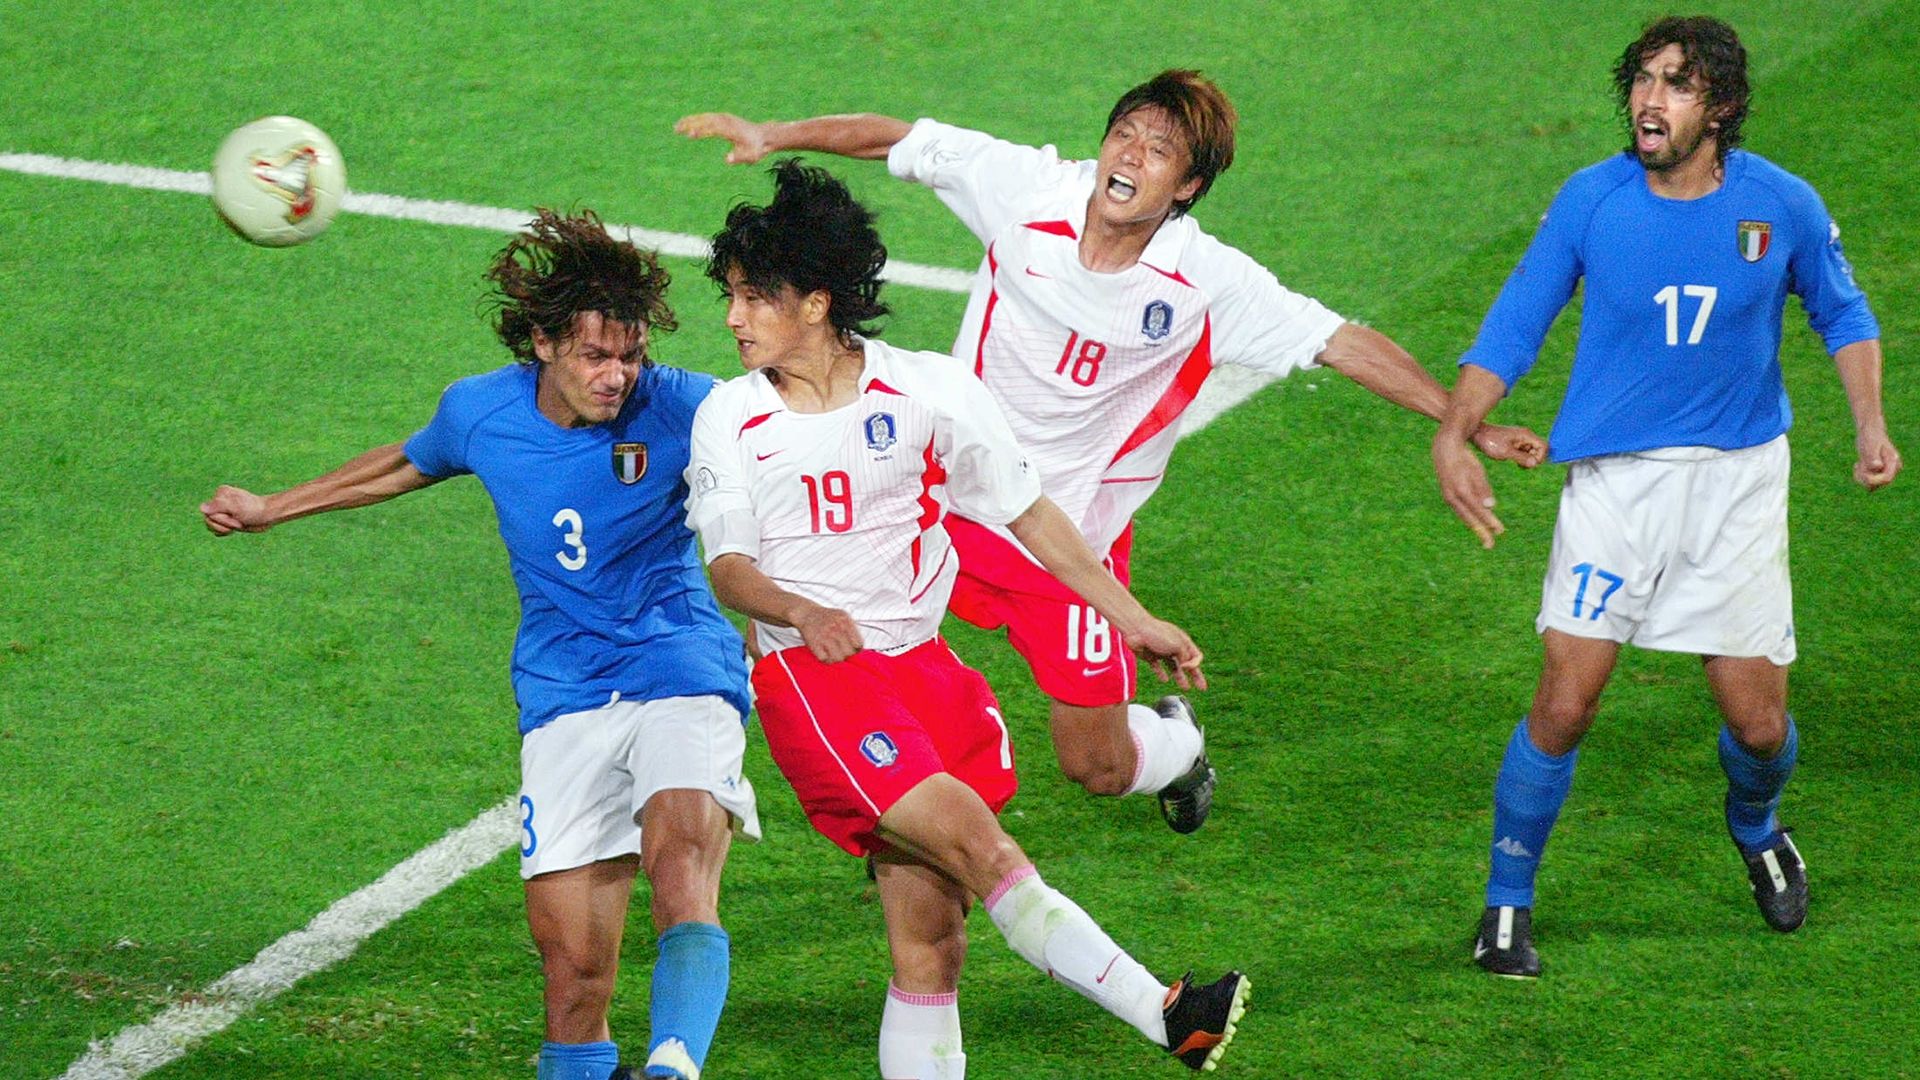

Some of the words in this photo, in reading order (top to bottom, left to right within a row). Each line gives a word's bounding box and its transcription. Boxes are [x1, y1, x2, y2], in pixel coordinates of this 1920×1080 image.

[1653, 284, 1718, 346] 17
[1055, 330, 1109, 387] 18
[801, 470, 853, 533] 19
[552, 508, 588, 571] 3
[1571, 561, 1625, 621] 17
[1066, 603, 1112, 663] 18
[519, 795, 538, 858] 3
